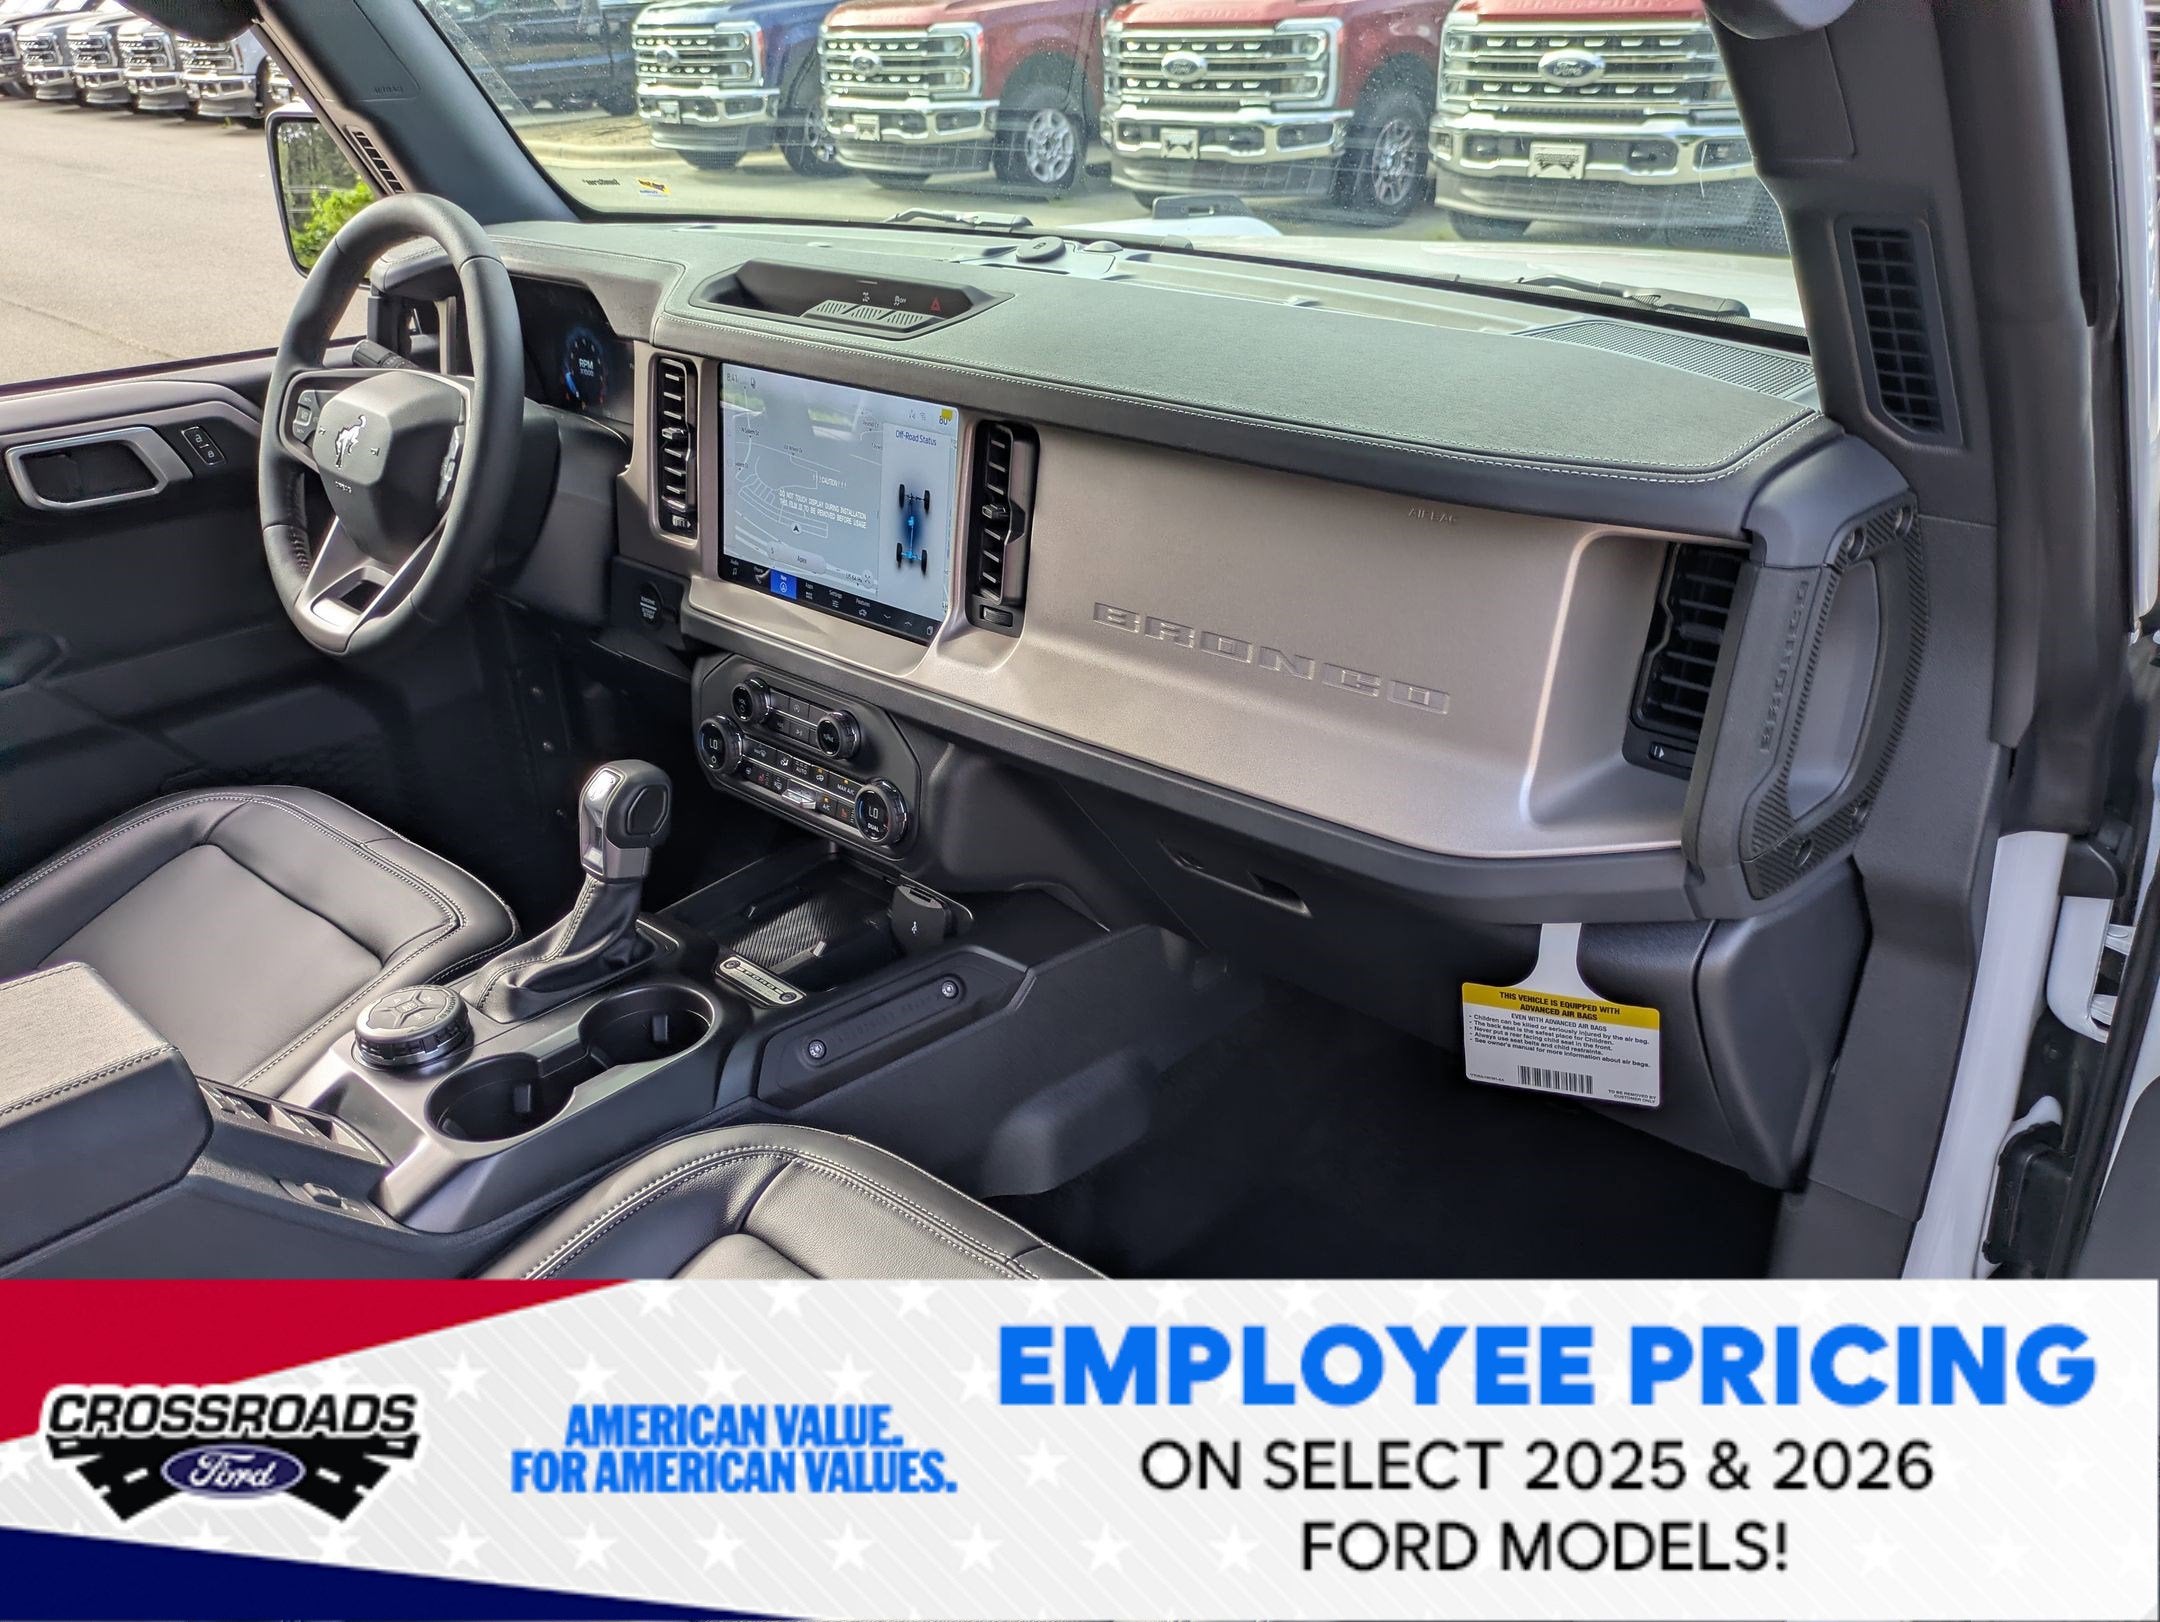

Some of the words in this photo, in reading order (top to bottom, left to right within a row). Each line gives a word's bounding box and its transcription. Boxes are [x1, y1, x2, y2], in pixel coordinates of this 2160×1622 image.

[578, 358, 594, 370] RPM
[895, 430, 918, 442] Off-Road
[920, 434, 937, 446] Status
[1094, 601, 1451, 715] BRONCO
[867, 822, 880, 833] DUAL
[1500, 992, 1516, 1000] THIS
[1518, 994, 1548, 1006] VEHICLE
[1560, 1000, 1598, 1012] EQUIPPED
[1600, 1006, 1620, 1015] WITH
[1520, 1004, 1560, 1016] ADVANCED
[1562, 1010, 1574, 1018] AIR
[1577, 1012, 1598, 1021] BAGS
[1474, 1014, 1500, 1024] Children
[1548, 1026, 1578, 1035] seriously
[1579, 1030, 1602, 1038] injured
[1511, 1013, 1527, 1021] EVEN
[1544, 1018, 1576, 1028] ADVANCED
[1578, 1022, 1589, 1030] AIR
[1590, 1024, 1608, 1032] BAGS
[1474, 1032, 1497, 1041] Always
[1524, 1034, 1543, 1042] facing
[1544, 1036, 1560, 1044] child
[1555, 1032, 1573, 1040] place
[1584, 1036, 1614, 1046] Children.
[1488, 1040, 1511, 1048] owner's
[1512, 1043, 1535, 1051] manual
[1564, 1051, 1600, 1061] information
[1602, 1056, 1621, 1064] about
